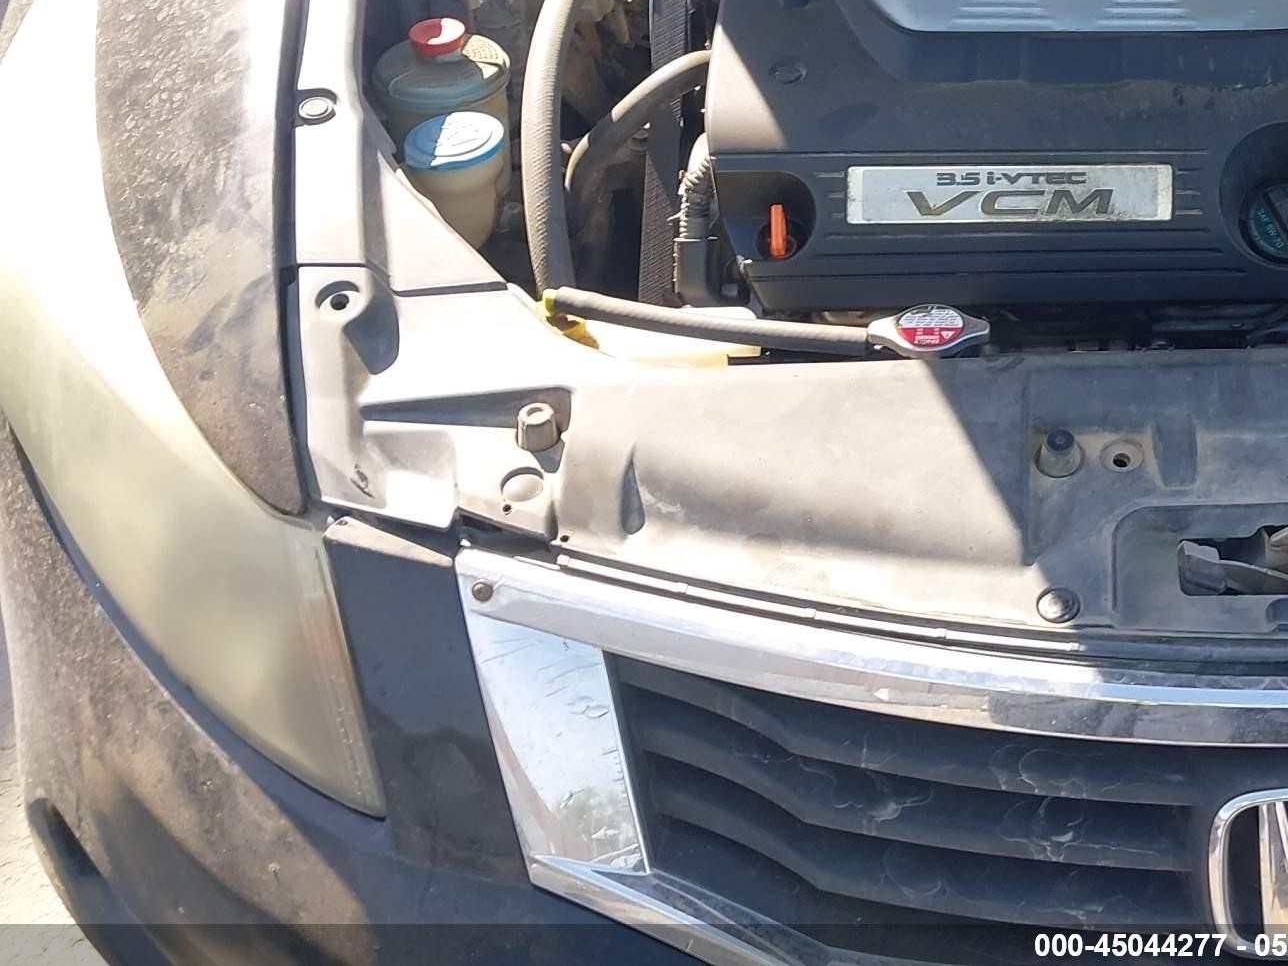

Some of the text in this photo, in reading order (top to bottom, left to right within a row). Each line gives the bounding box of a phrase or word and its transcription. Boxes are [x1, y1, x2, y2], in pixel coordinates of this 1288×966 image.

[935, 170, 1088, 187] 3.5 i-VTEC
[904, 188, 1115, 217] VCM
